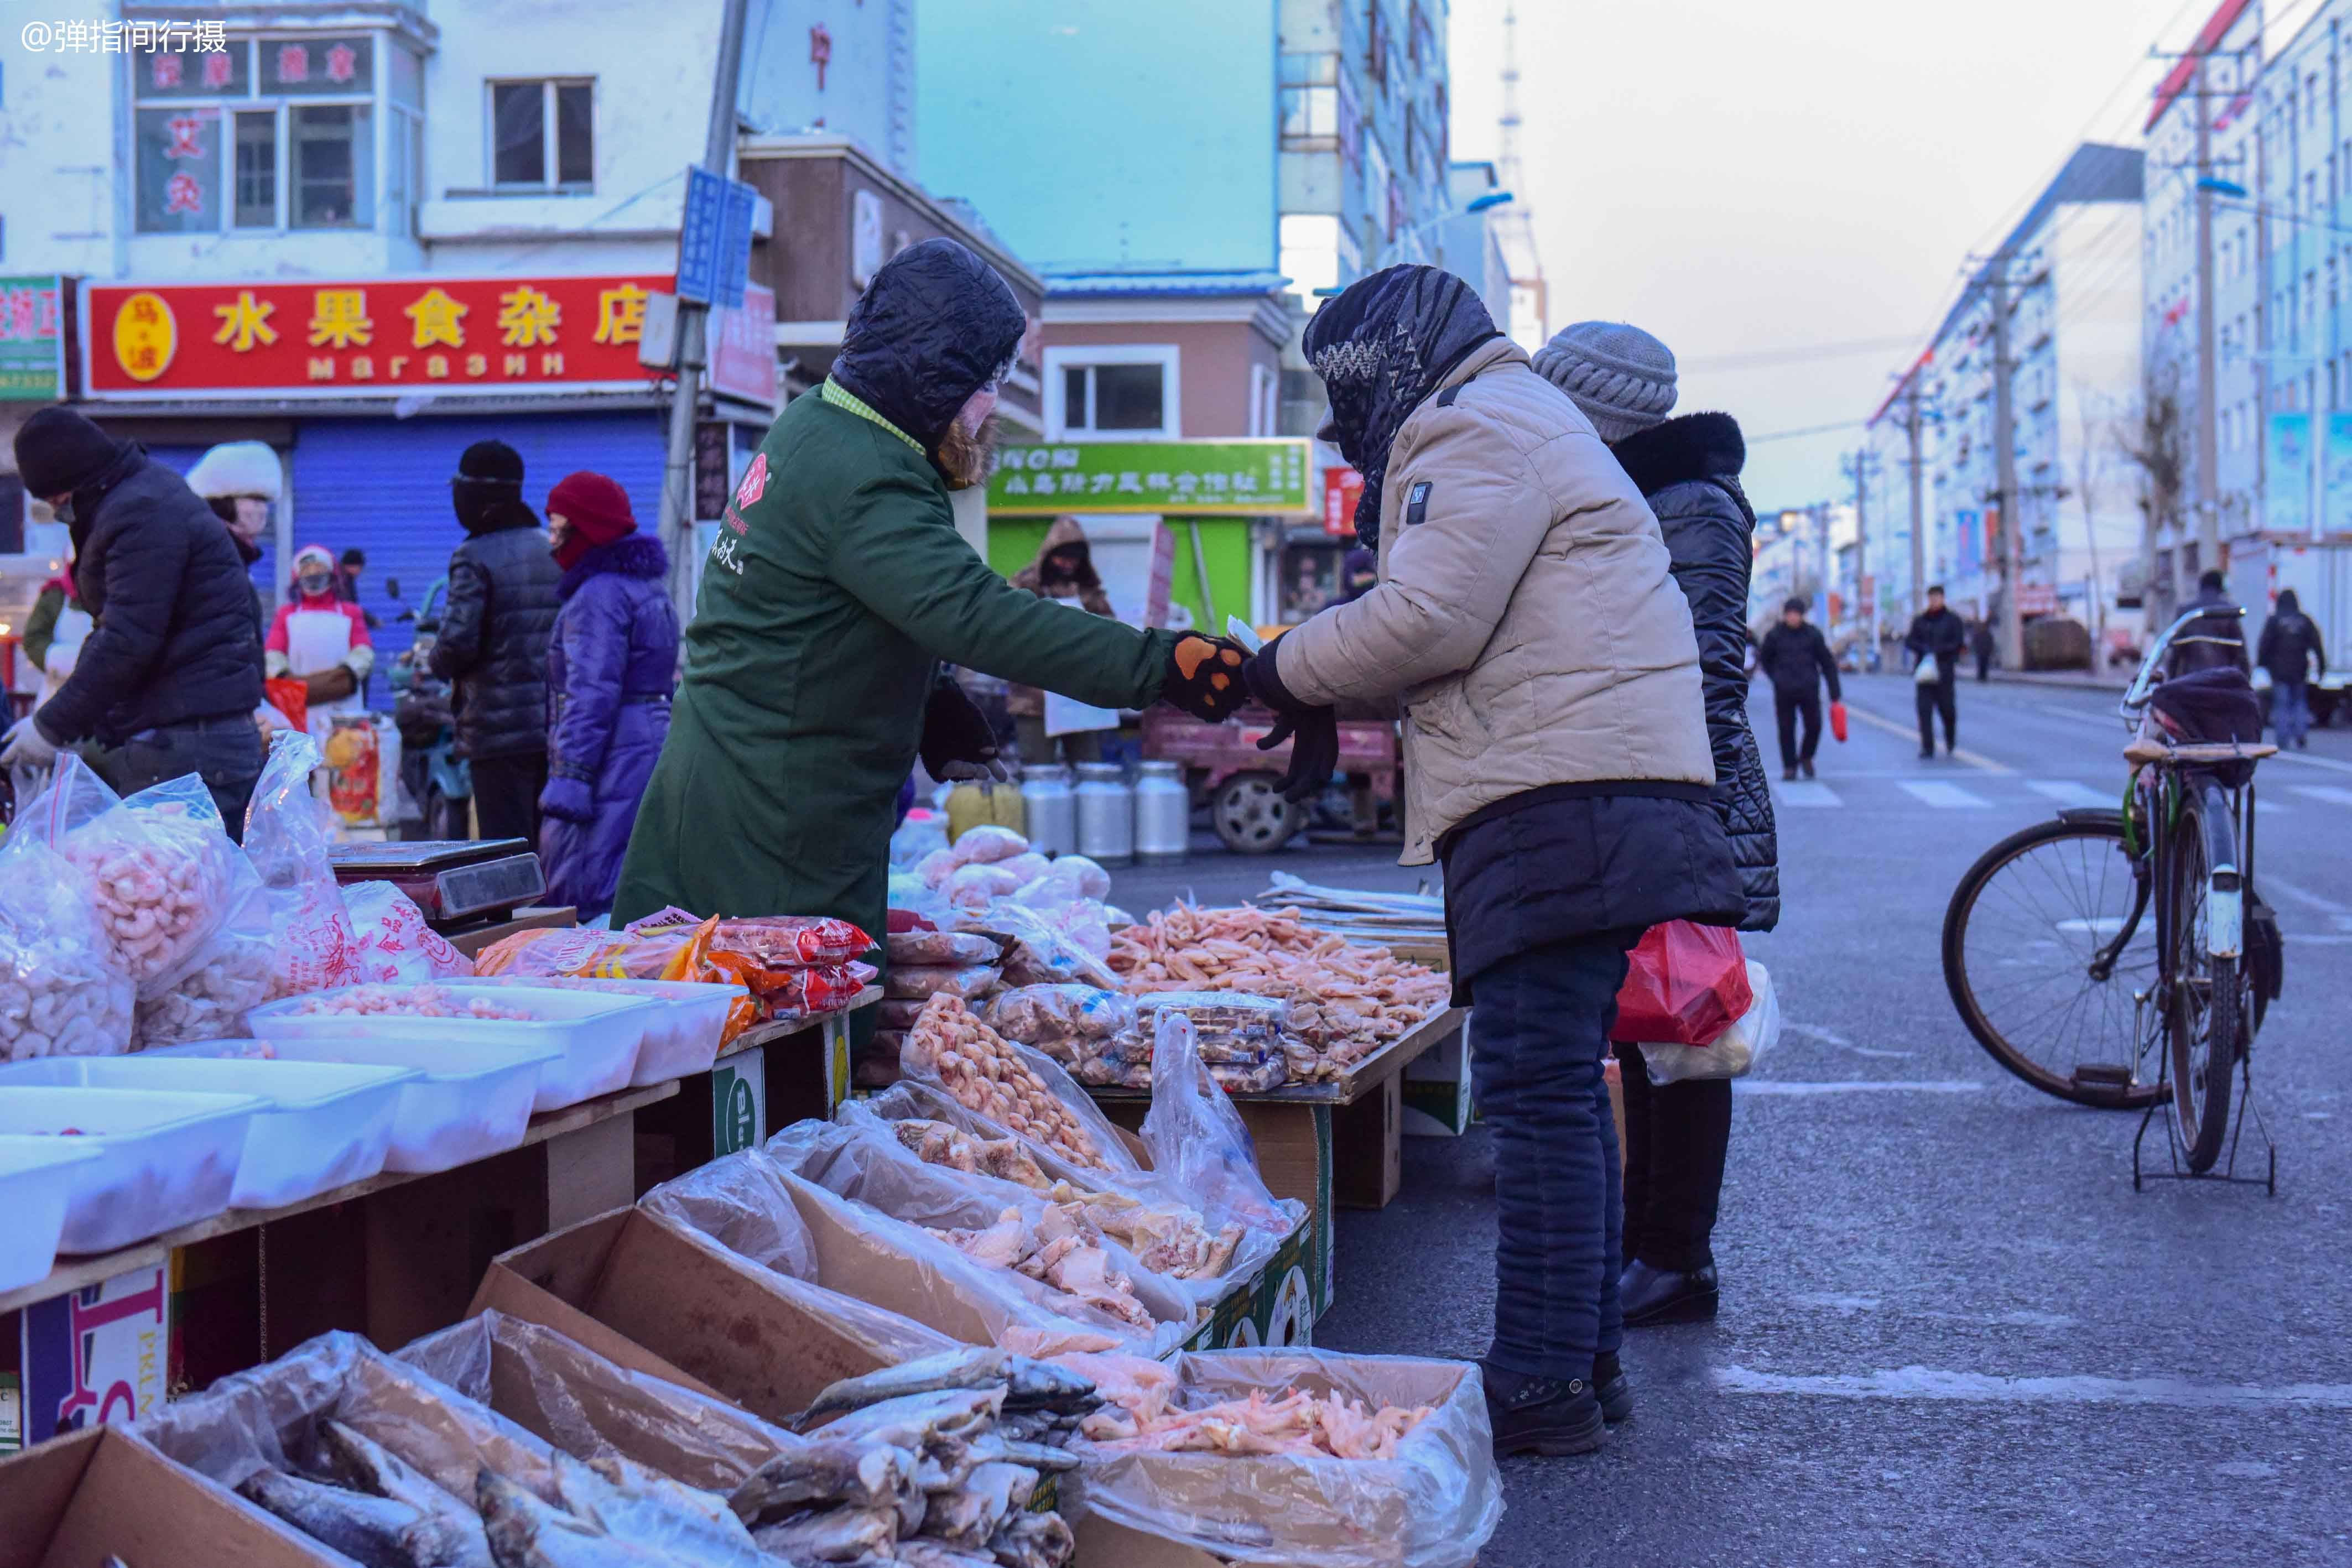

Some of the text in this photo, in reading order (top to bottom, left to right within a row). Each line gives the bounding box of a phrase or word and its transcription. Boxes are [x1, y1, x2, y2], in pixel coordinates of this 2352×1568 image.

[214, 283, 649, 352] 水果食杂店
